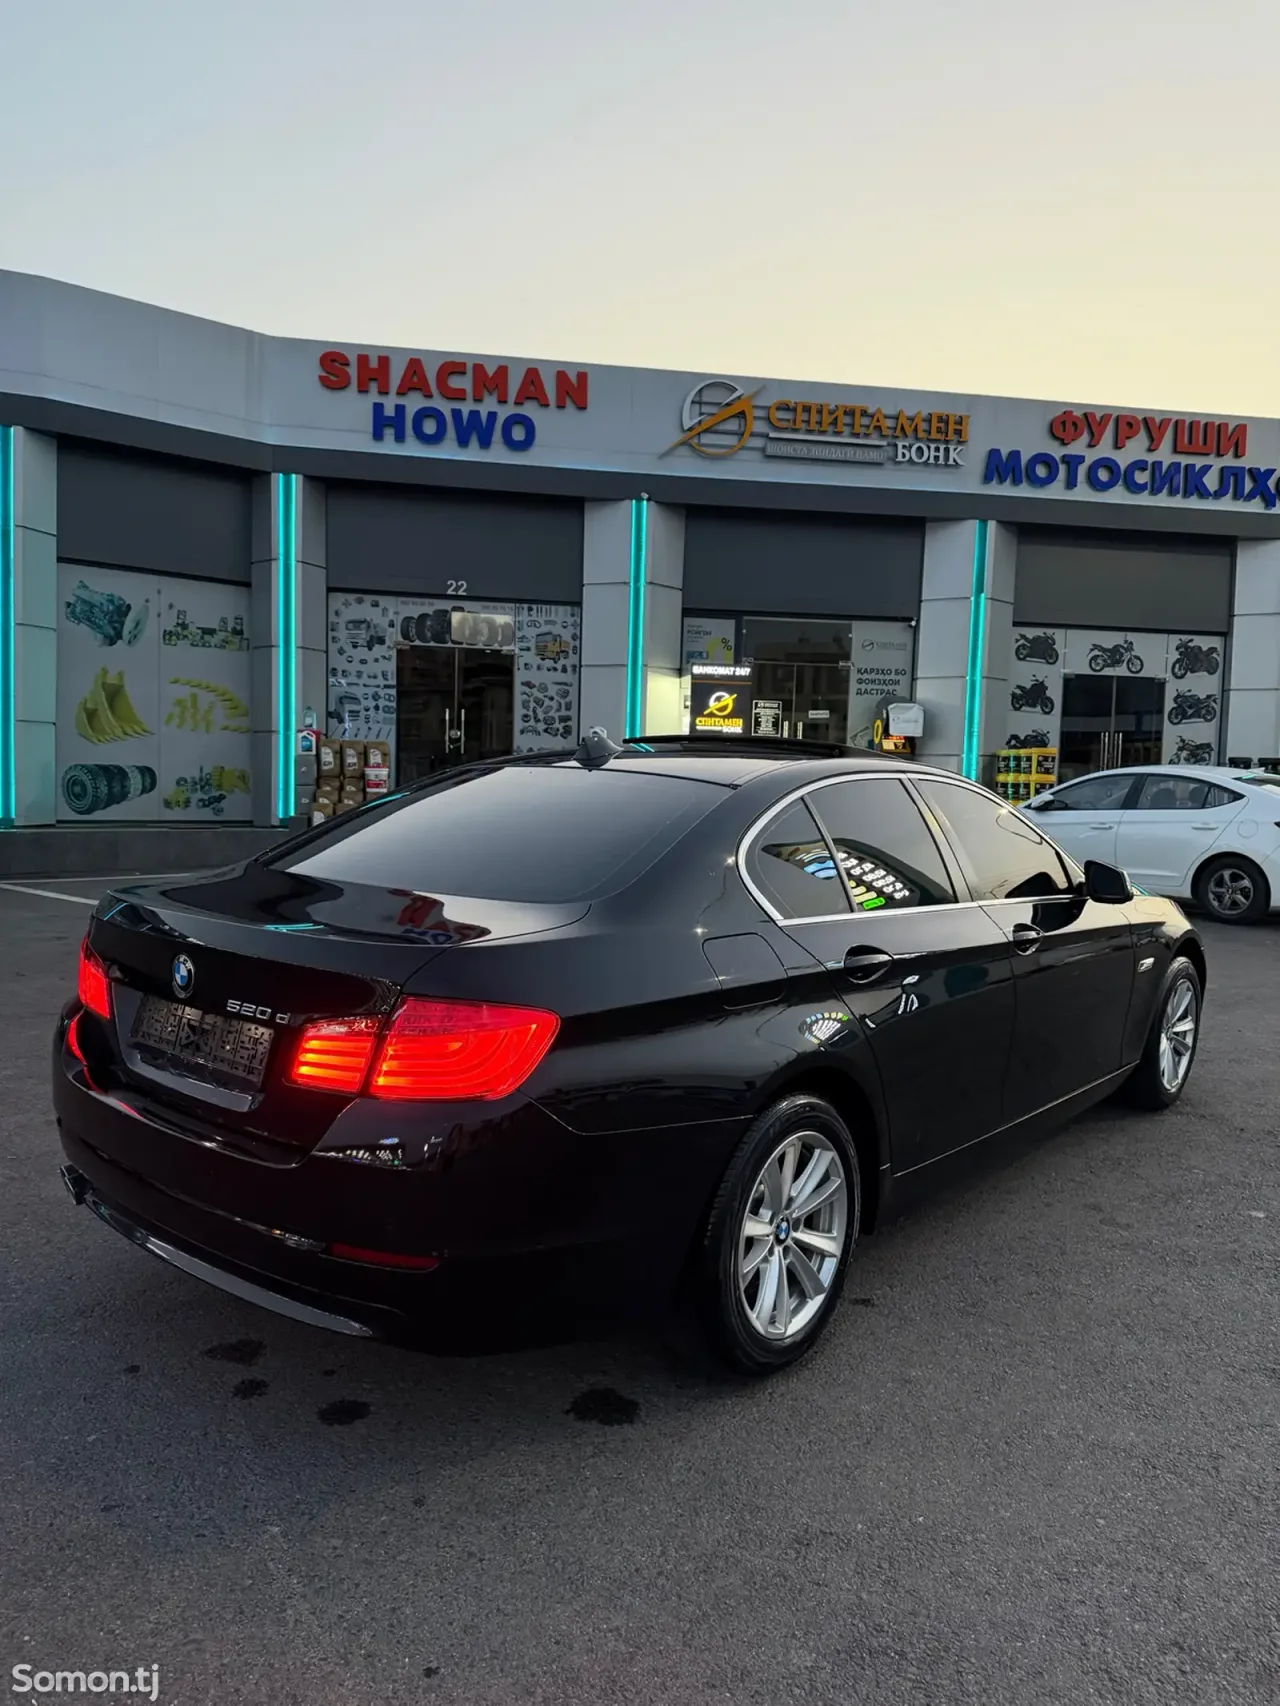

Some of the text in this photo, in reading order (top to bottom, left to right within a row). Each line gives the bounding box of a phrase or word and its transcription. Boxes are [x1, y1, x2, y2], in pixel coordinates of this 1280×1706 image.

[318, 350, 588, 410] SHACMAN
[372, 401, 537, 452] HOWO
[768, 400, 971, 442] СПИТАМЕН
[1050, 410, 1248, 458] ФУРУШИ
[895, 441, 966, 466] БОНК
[983, 447, 1280, 510] МОТОСИКЛҲ
[446, 579, 468, 596] 22
[692, 665, 734, 676] БАНКОМАТ
[894, 668, 907, 676] БО
[856, 688, 897, 697] ДАСТРАС
[695, 717, 743, 728] СПИТАМЕН
[226, 999, 291, 1024] 520 d
